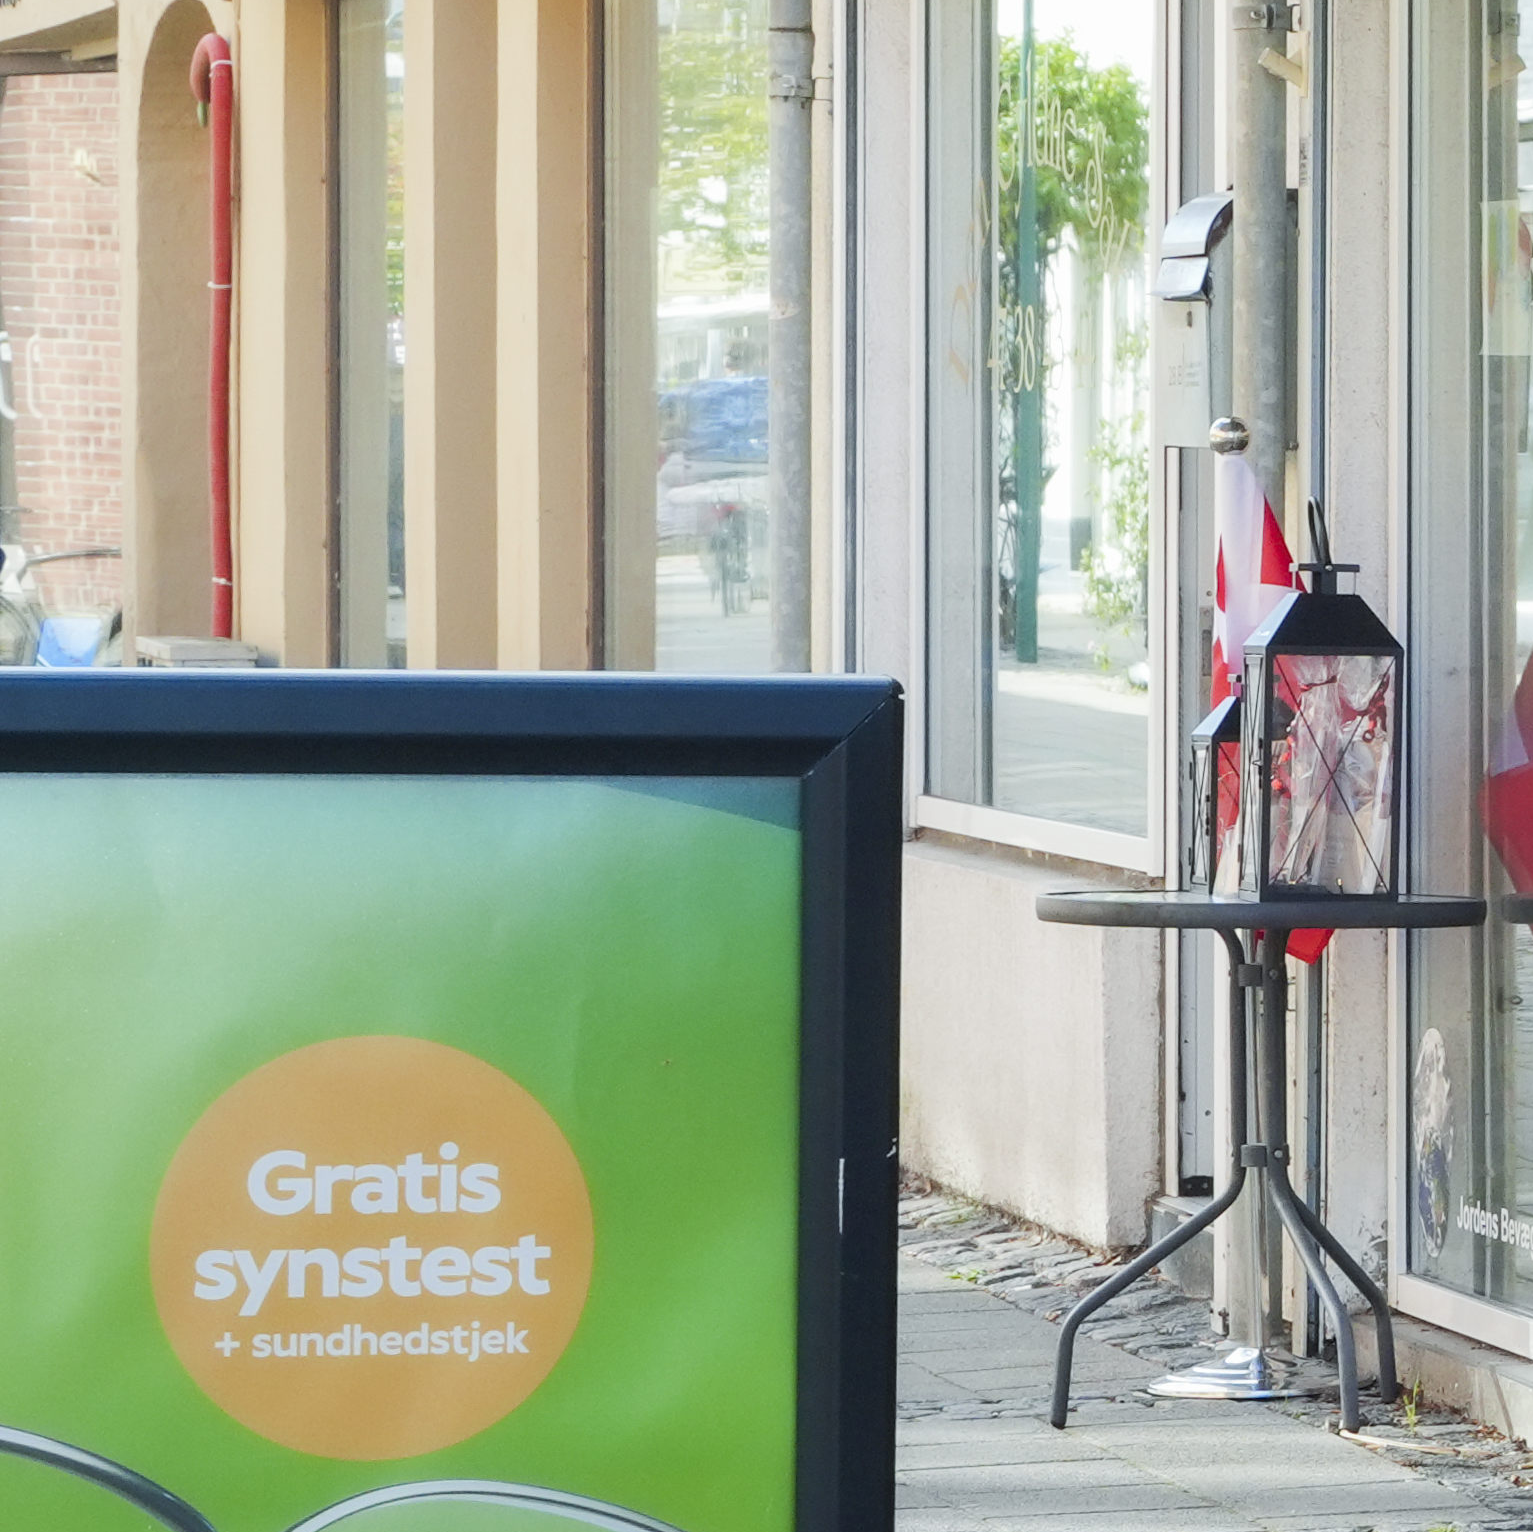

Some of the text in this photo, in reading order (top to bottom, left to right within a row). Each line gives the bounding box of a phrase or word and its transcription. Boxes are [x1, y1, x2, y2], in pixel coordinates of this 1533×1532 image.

[247, 1140, 502, 1216] Gratis
[1456, 1195, 1499, 1240] Jordens
[193, 1234, 552, 1317] synstest
[251, 1321, 530, 1364] sundhedstjek
